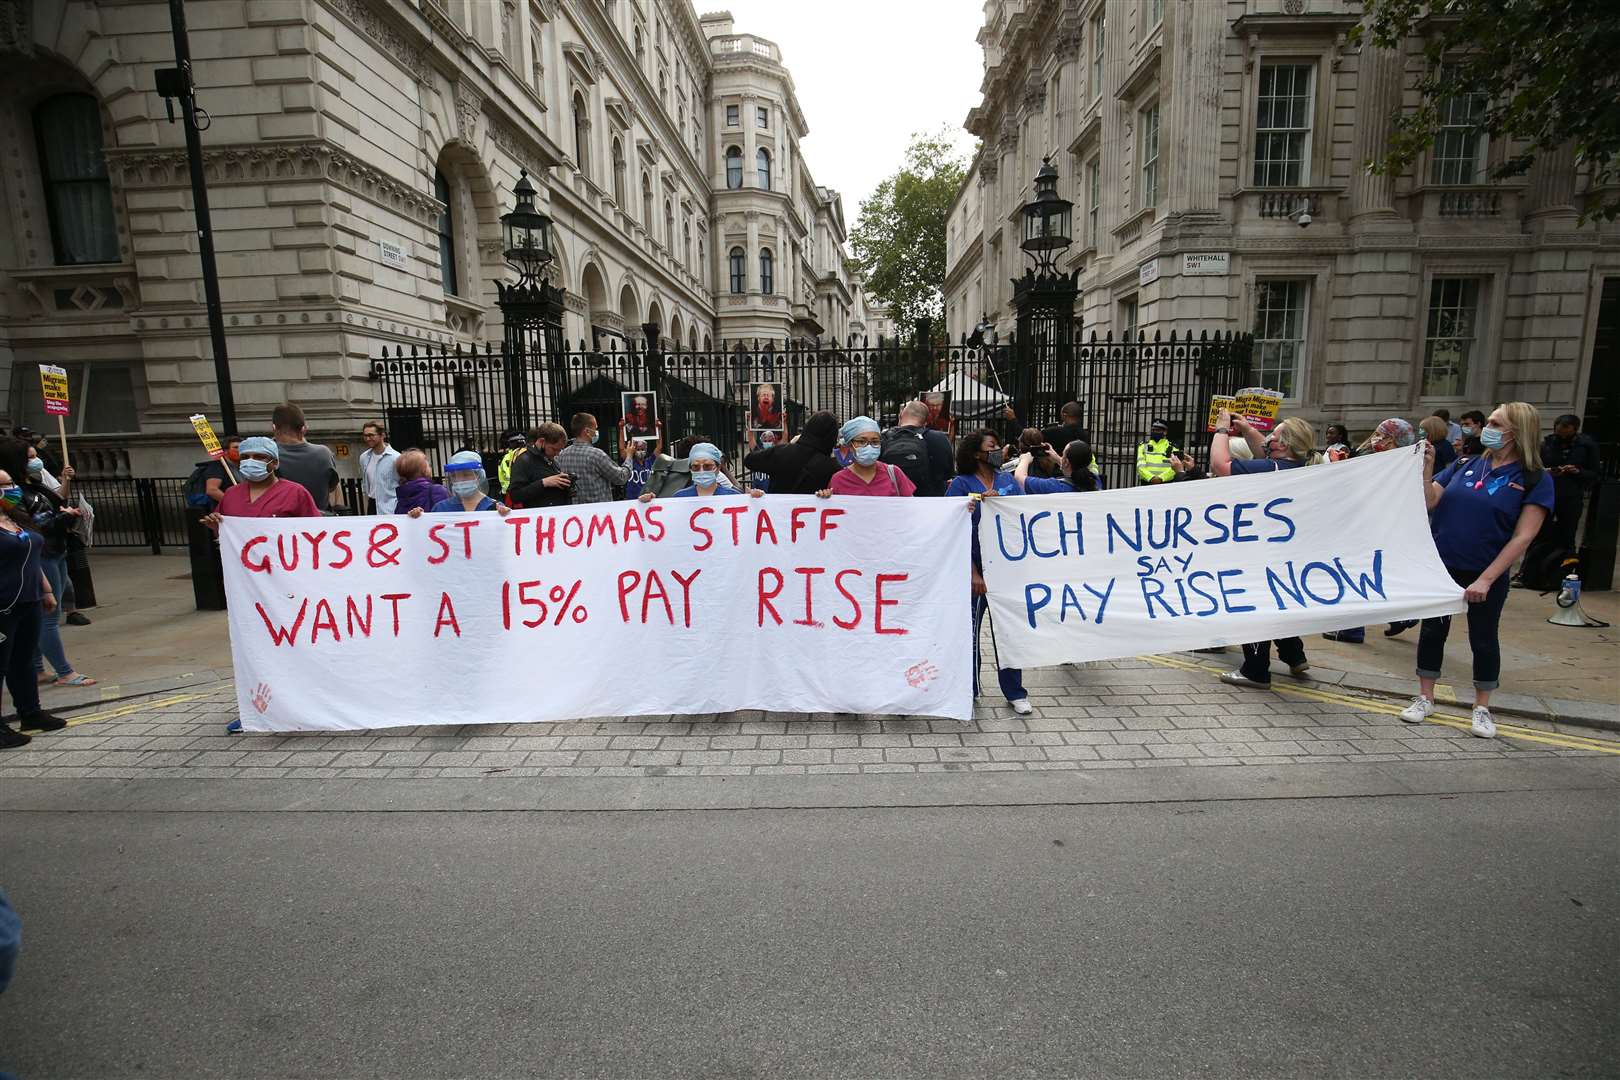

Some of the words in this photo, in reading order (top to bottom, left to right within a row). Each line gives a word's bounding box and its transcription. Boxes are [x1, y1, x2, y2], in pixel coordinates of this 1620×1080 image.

[1252, 396, 1279, 406] Migrants
[241, 530, 353, 574] GUYS
[366, 523, 401, 568] &
[427, 520, 480, 565] ST
[505, 506, 666, 556] THOMAS
[689, 506, 846, 552] STAFF
[995, 511, 1085, 561] UCH
[1106, 497, 1296, 554] NURSES
[1025, 577, 1115, 629] PAY
[1140, 568, 1256, 619] RISE
[1265, 549, 1387, 611] NOW
[1137, 552, 1194, 577] SAY
[255, 593, 412, 647] WANT
[434, 592, 462, 637] A
[502, 579, 588, 630] 15%
[617, 568, 702, 629] PAY
[758, 566, 909, 634] RISE
